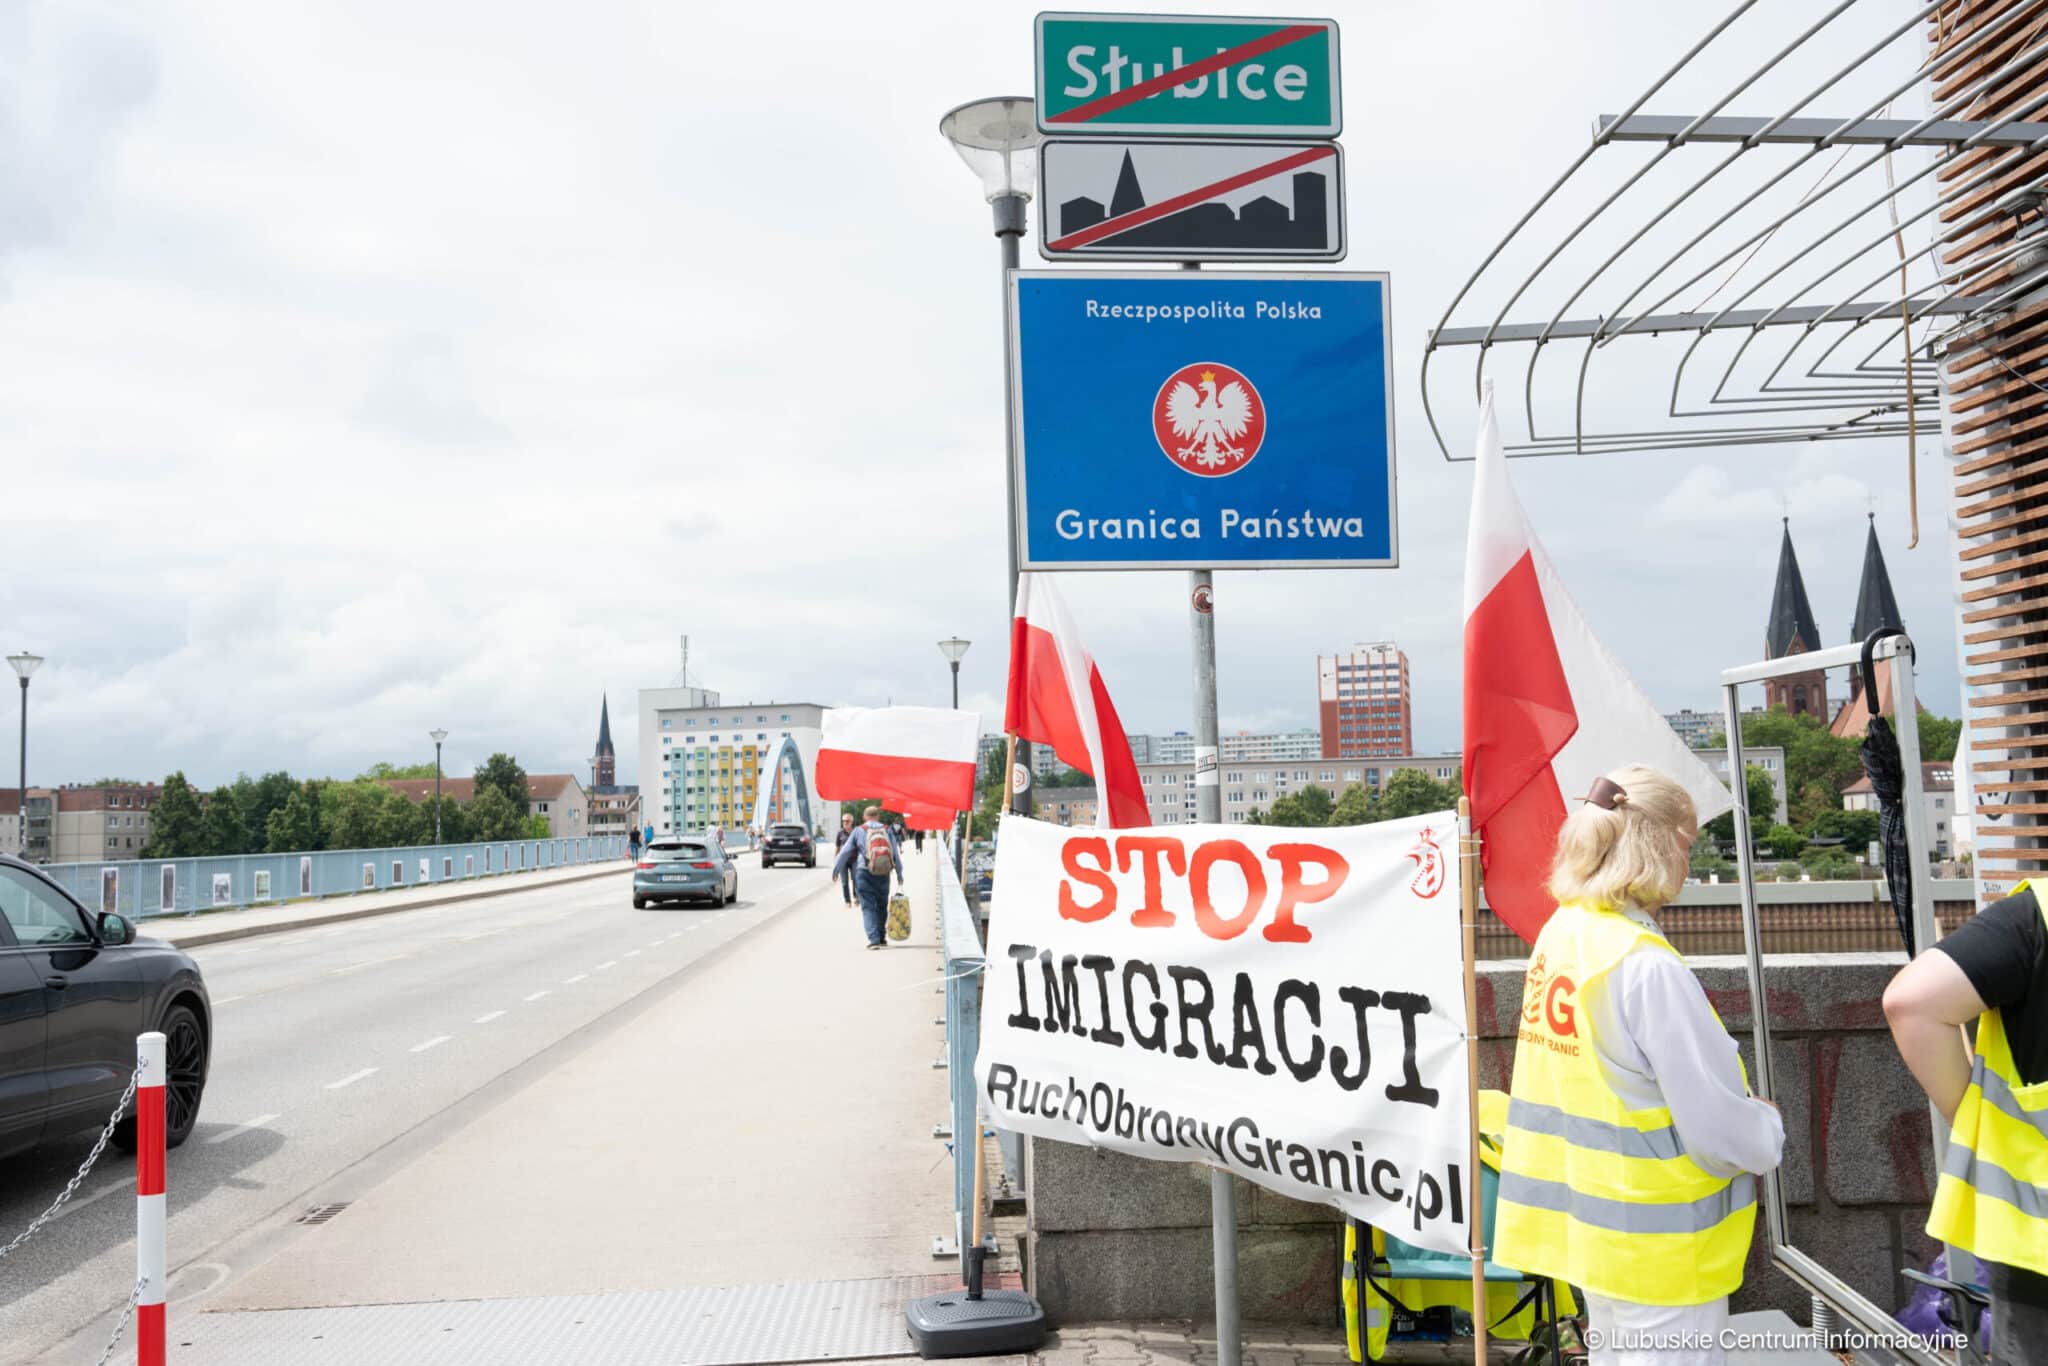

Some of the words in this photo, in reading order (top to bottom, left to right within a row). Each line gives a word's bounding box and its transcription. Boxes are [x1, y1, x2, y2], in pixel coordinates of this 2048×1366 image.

[1064, 45, 1308, 101] Słubice
[1086, 299, 1245, 324] Rzeczpospolita
[1255, 301, 1322, 319] Polska
[1055, 509, 1201, 540] Granica
[1221, 508, 1364, 539] Państwa
[1058, 836, 1350, 943] STOP
[1007, 943, 1440, 1109] IMIGRACJI
[1548, 1039, 1580, 1057] RANIC
[987, 1062, 1464, 1231] RuchObronyGranic.pl
